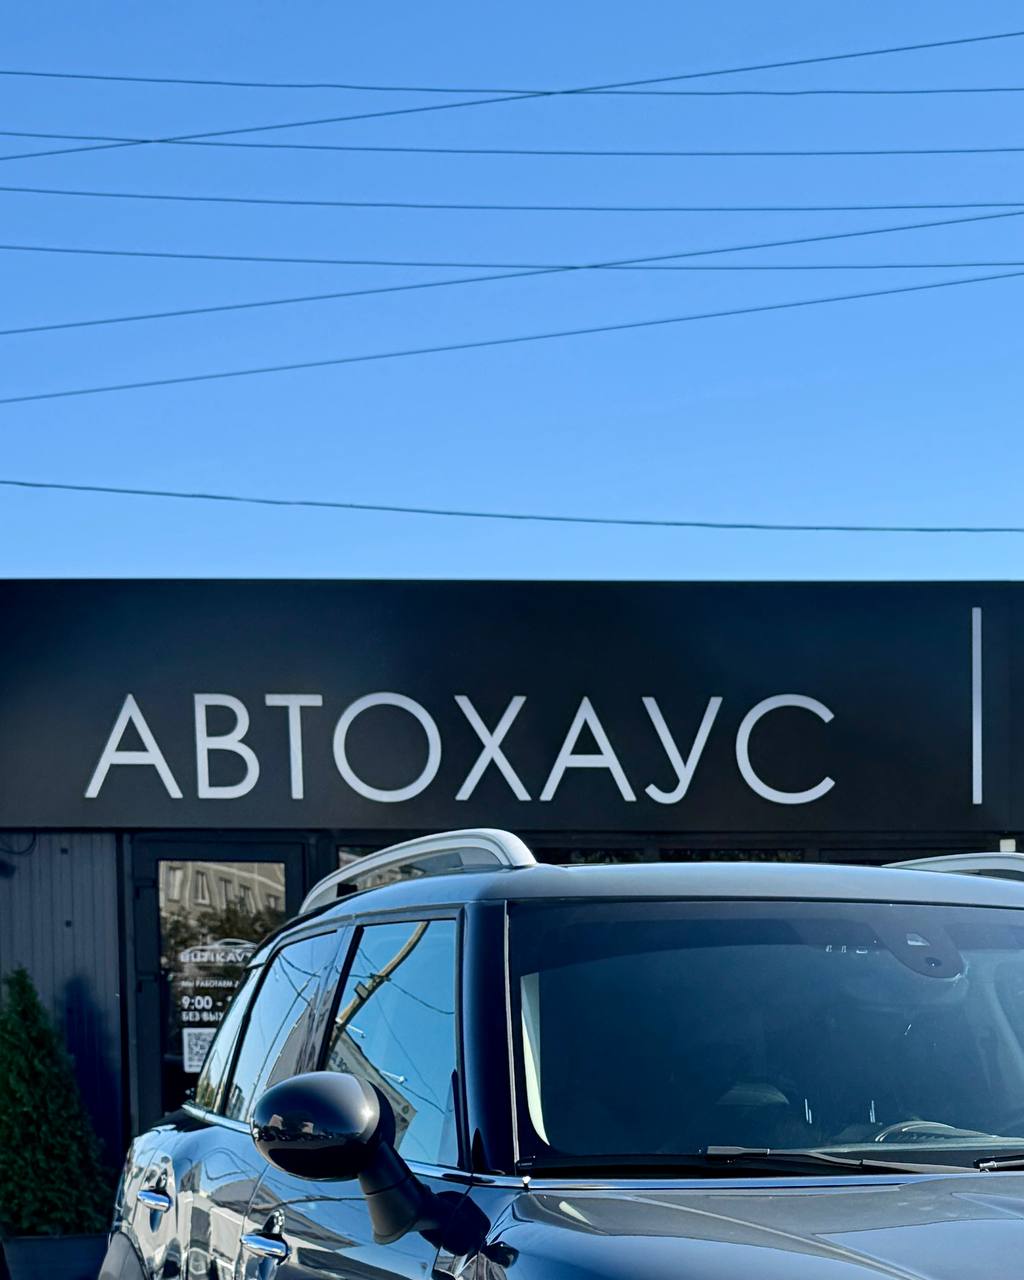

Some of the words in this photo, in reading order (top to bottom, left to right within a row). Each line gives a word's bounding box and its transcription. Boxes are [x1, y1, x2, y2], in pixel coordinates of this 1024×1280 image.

[84, 691, 837, 805] АВТОХАУС
[181, 951, 252, 962] BUTIKAV
[182, 995, 213, 1009] 9:00
